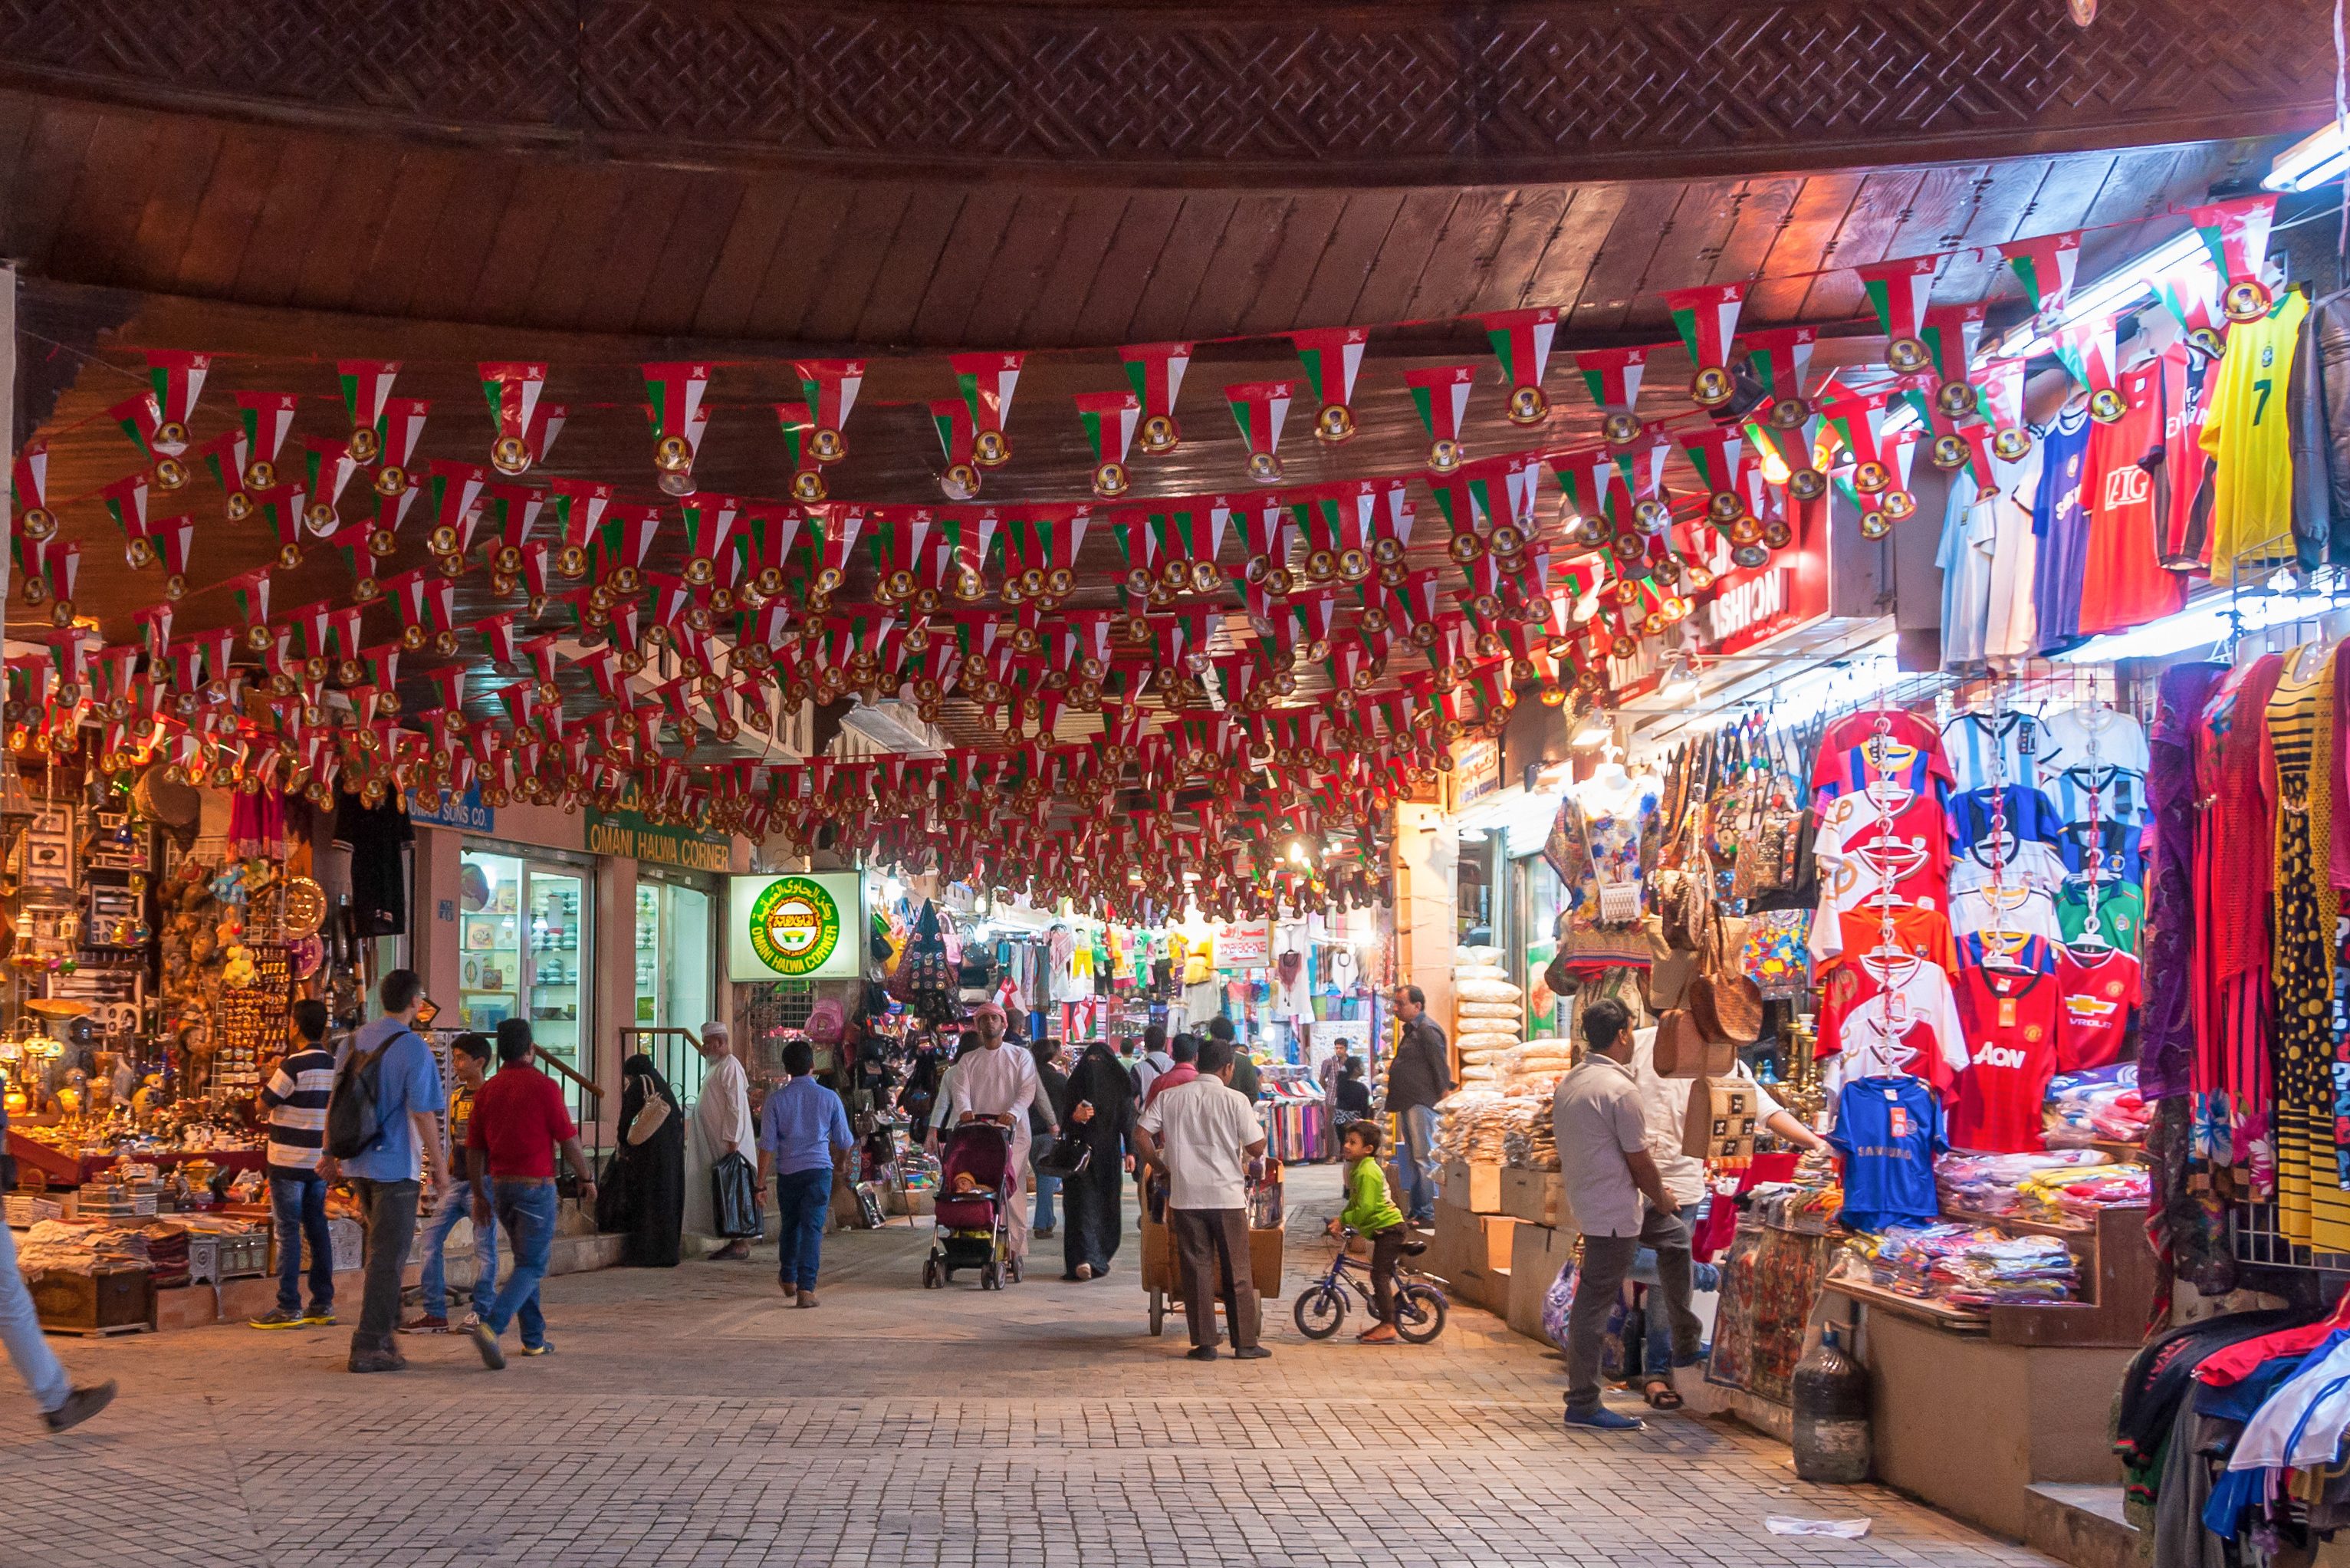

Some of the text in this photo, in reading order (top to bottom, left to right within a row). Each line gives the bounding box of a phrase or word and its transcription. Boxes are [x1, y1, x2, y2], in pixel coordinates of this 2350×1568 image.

[2253, 380, 2272, 426] 7
[2105, 465, 2148, 510] AIG
[1708, 567, 1781, 640] ASHION
[442, 802, 468, 824] SONS
[472, 807, 487, 827] CO.
[590, 823, 730, 872] OMANI HALWA CORNER
[751, 926, 775, 962] OMANI
[771, 955, 806, 973] HALWA
[805, 925, 838, 969] CORNER
